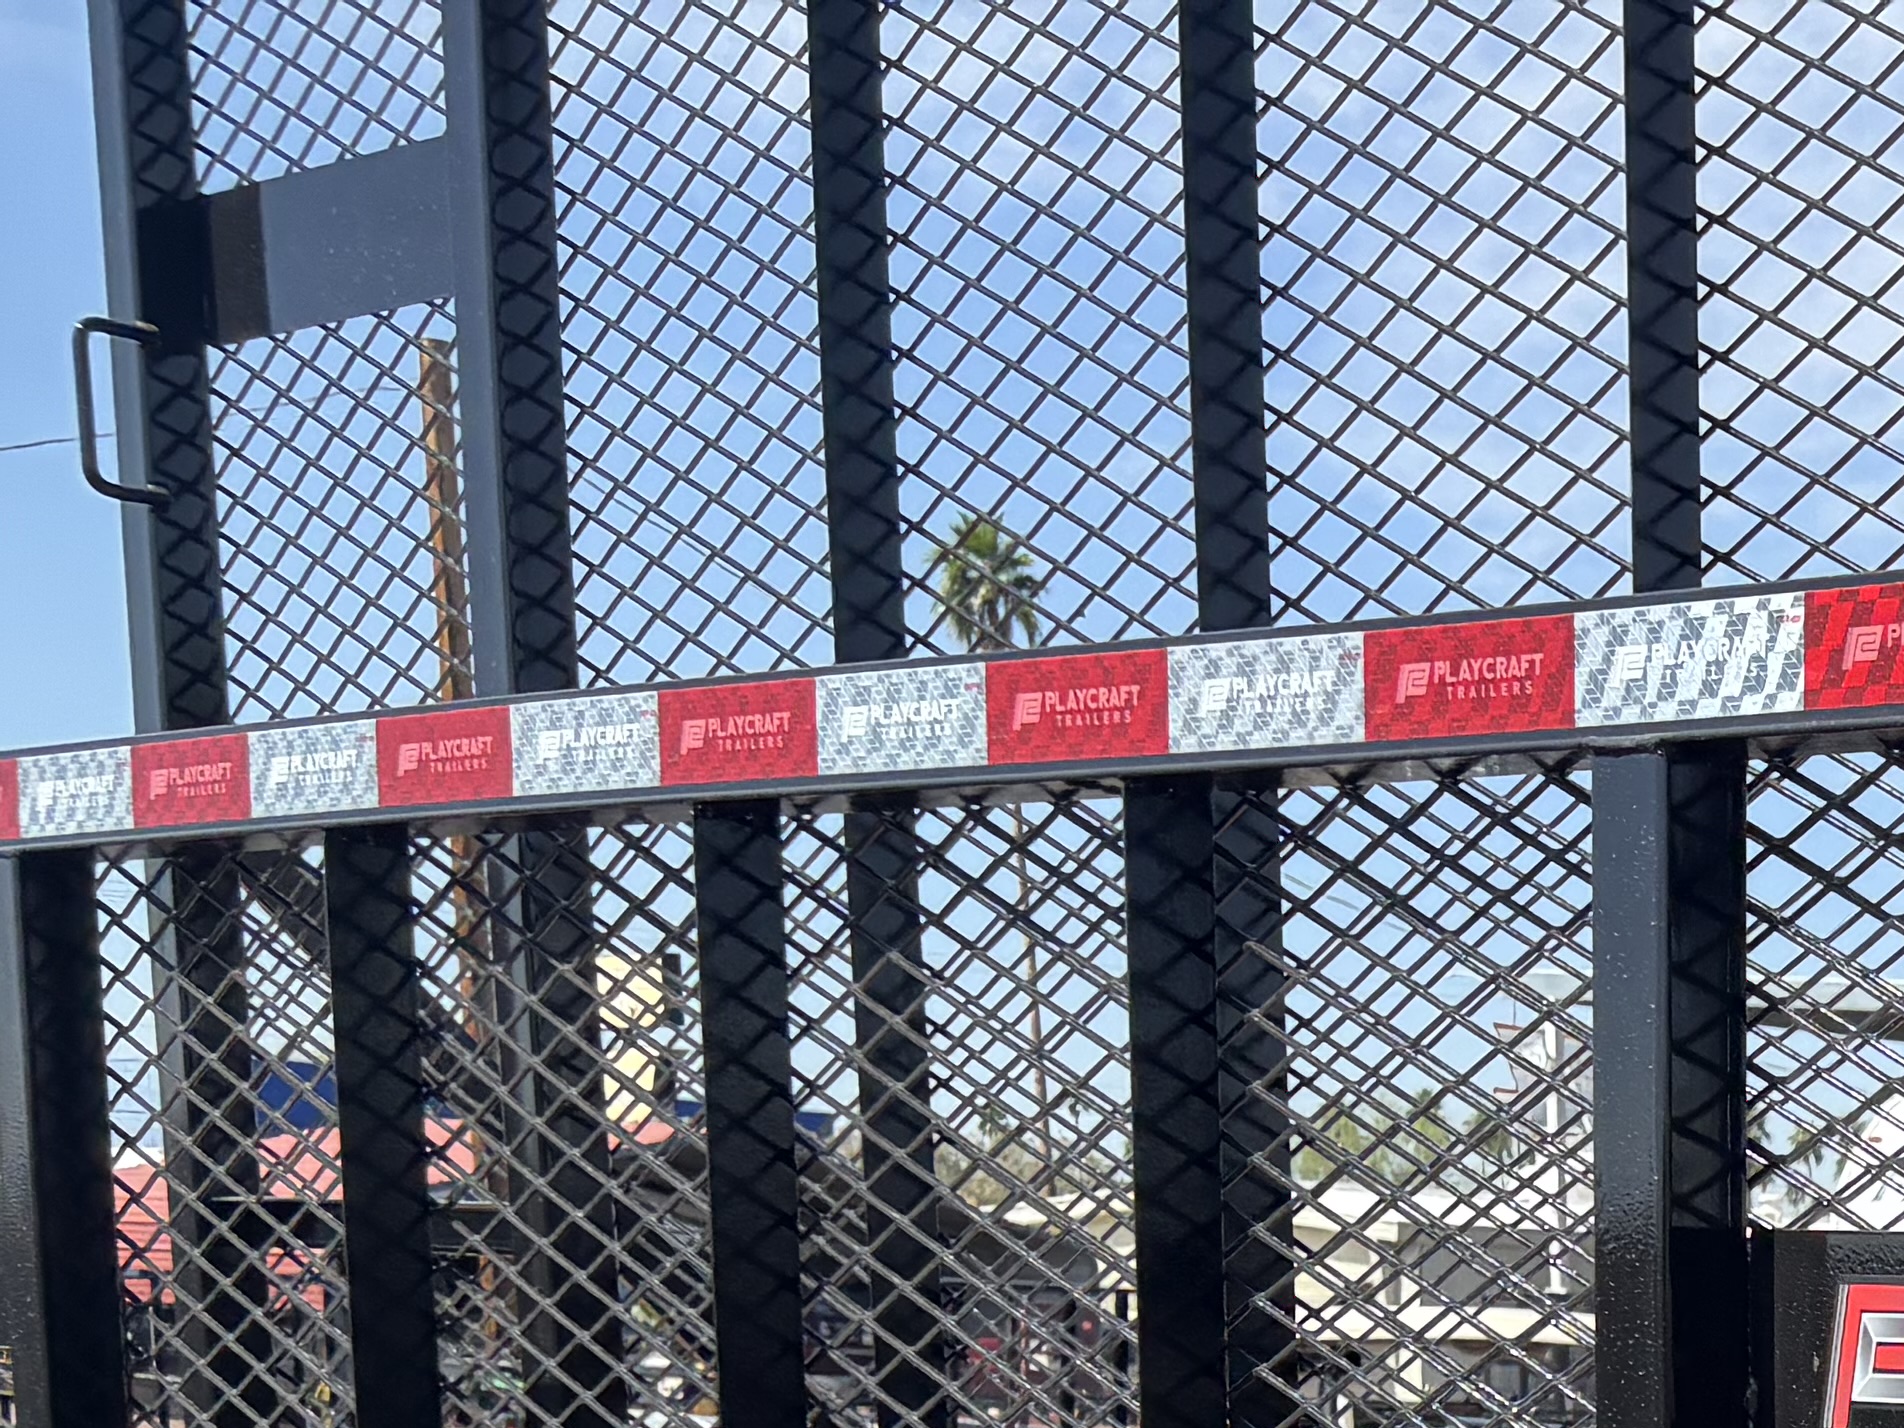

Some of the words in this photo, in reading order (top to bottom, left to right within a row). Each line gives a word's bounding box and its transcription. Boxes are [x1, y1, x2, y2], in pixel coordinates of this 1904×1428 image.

[1433, 653, 1544, 684] PLAYCRAFT
[1231, 670, 1335, 699] PLAYCRAFT
[1446, 681, 1533, 700] TRAILERS
[1046, 685, 1140, 712] PLAYCRAFT
[871, 699, 960, 725] PLAYCRAFT
[1056, 710, 1131, 727] TRAILERS
[563, 724, 641, 748] PLAYCRAFT
[707, 711, 791, 738] PLAYCRAFT
[421, 735, 493, 759] PLAYCRAFT
[718, 735, 783, 753] TRAILERS
[169, 762, 232, 785] PLAYCRAFT
[290, 750, 358, 774] PLAYCRAFT
[430, 758, 487, 773] TRAILERS
